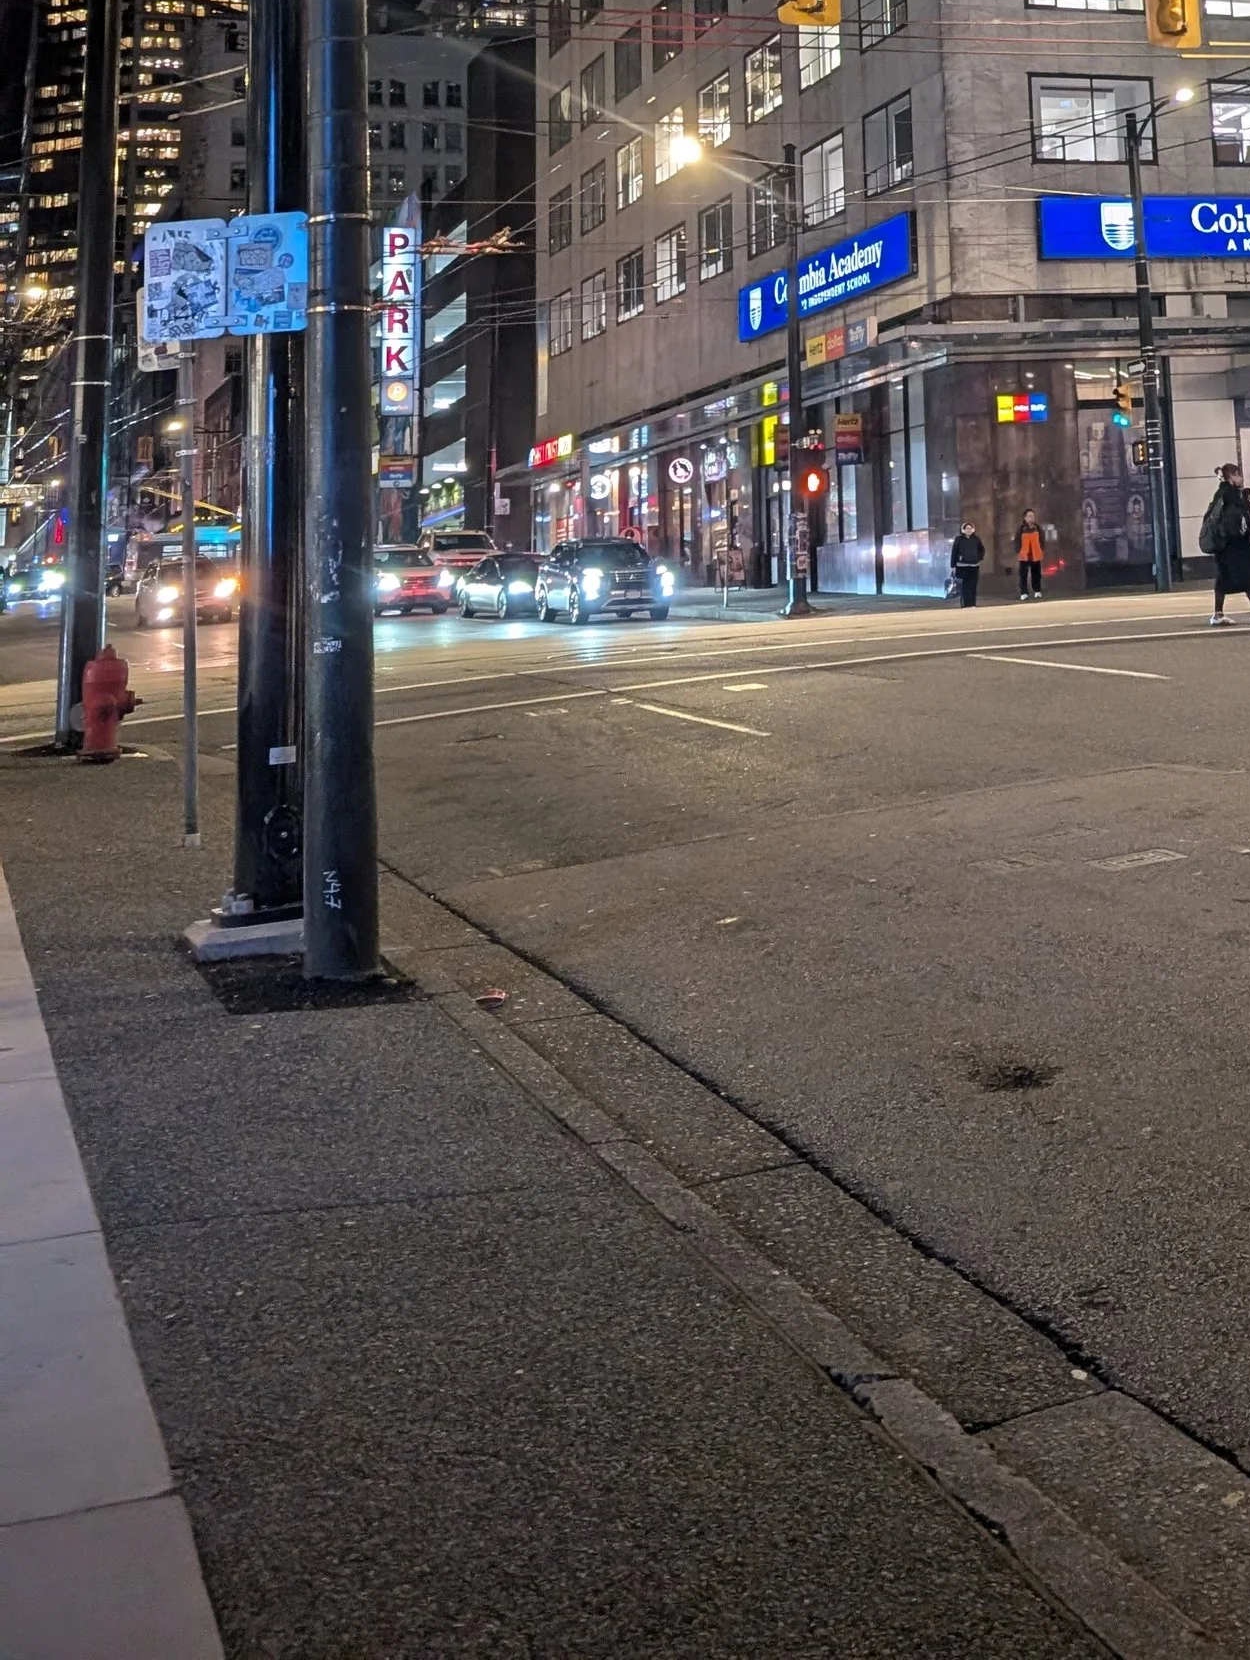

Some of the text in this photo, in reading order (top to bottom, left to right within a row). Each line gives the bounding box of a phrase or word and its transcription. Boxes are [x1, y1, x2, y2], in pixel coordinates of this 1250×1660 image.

[828, 240, 883, 282] Academy
[1227, 238, 1237, 251] A
[386, 233, 410, 372] PARK
[808, 282, 846, 307] INDEPENDENT
[846, 271, 871, 292] SCHOOL
[837, 418, 859, 426] Hertz
